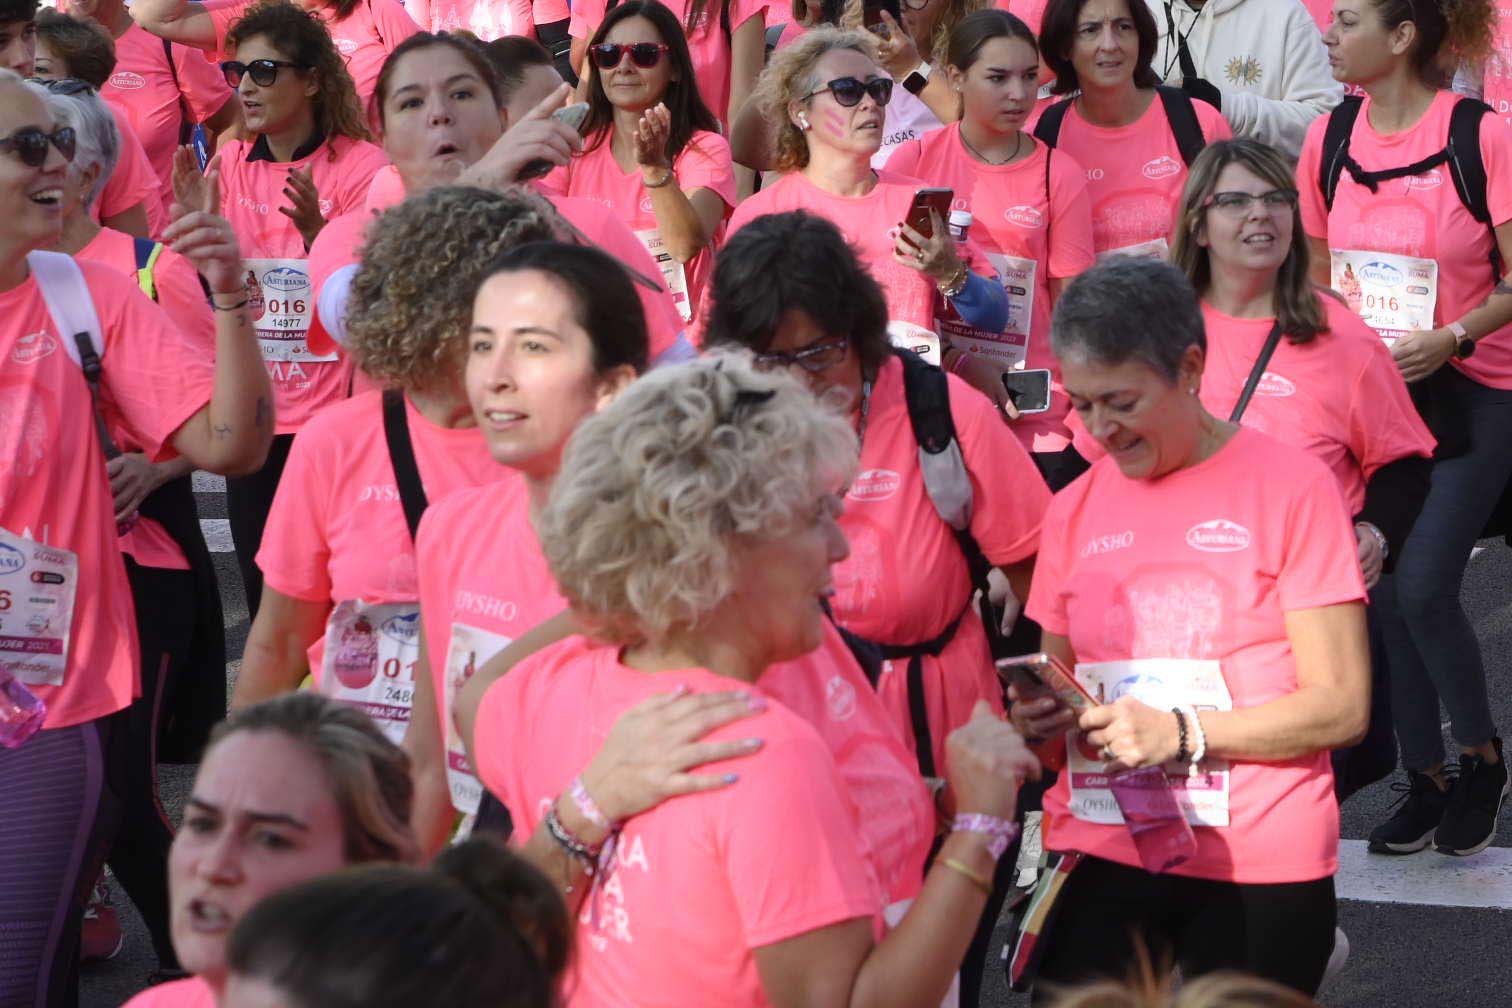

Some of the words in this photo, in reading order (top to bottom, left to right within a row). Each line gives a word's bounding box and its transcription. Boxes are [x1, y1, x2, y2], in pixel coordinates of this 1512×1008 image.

[268, 299, 306, 313] 016
[1366, 294, 1399, 311] 016
[272, 318, 301, 328] 14977
[384, 658, 417, 682] 01
[385, 687, 415, 703] 248
